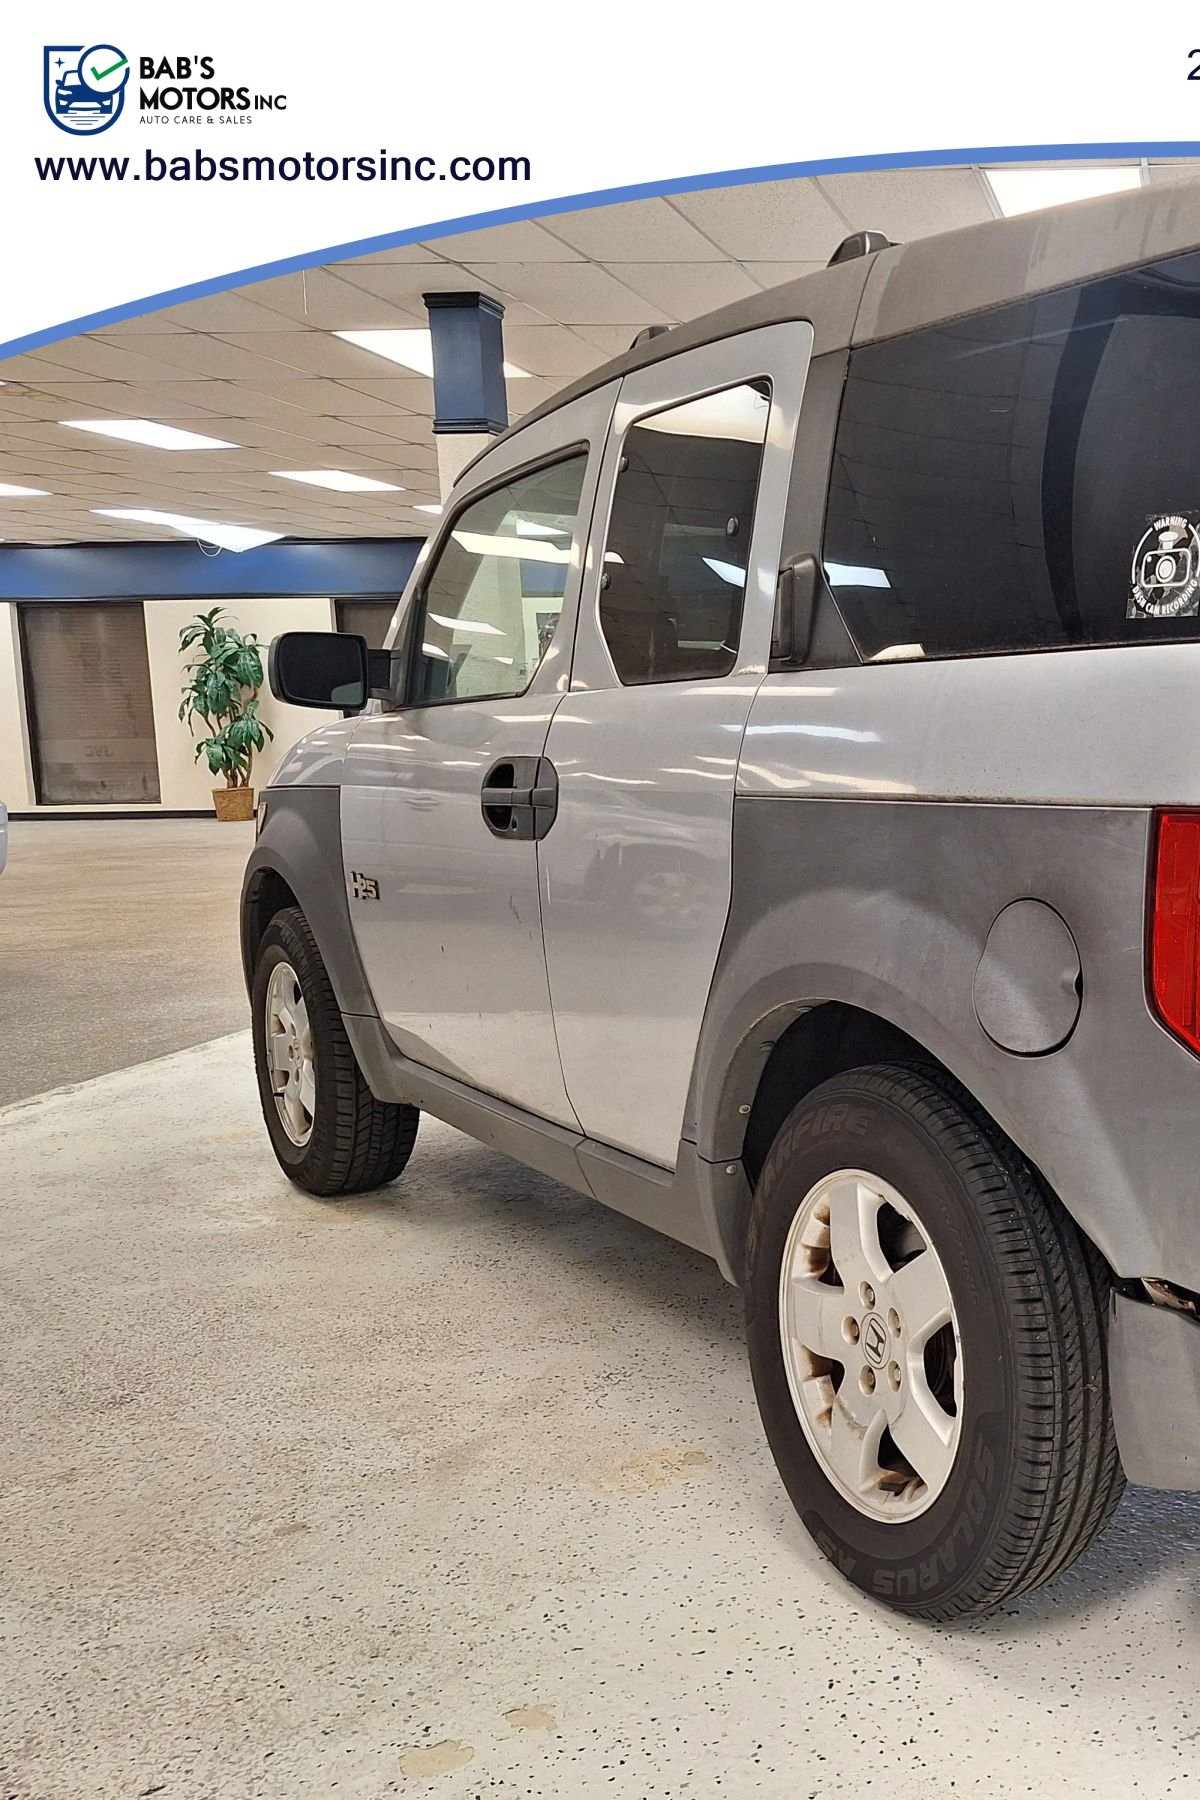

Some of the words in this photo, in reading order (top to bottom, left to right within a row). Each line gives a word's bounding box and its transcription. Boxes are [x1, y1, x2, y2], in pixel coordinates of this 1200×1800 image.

[1153, 516, 1188, 531] WARNING
[1132, 585, 1146, 608] DASH
[1145, 602, 1160, 615] CAM
[1162, 579, 1198, 614] RECORDING
[873, 1431, 996, 1596] SOLARUS
